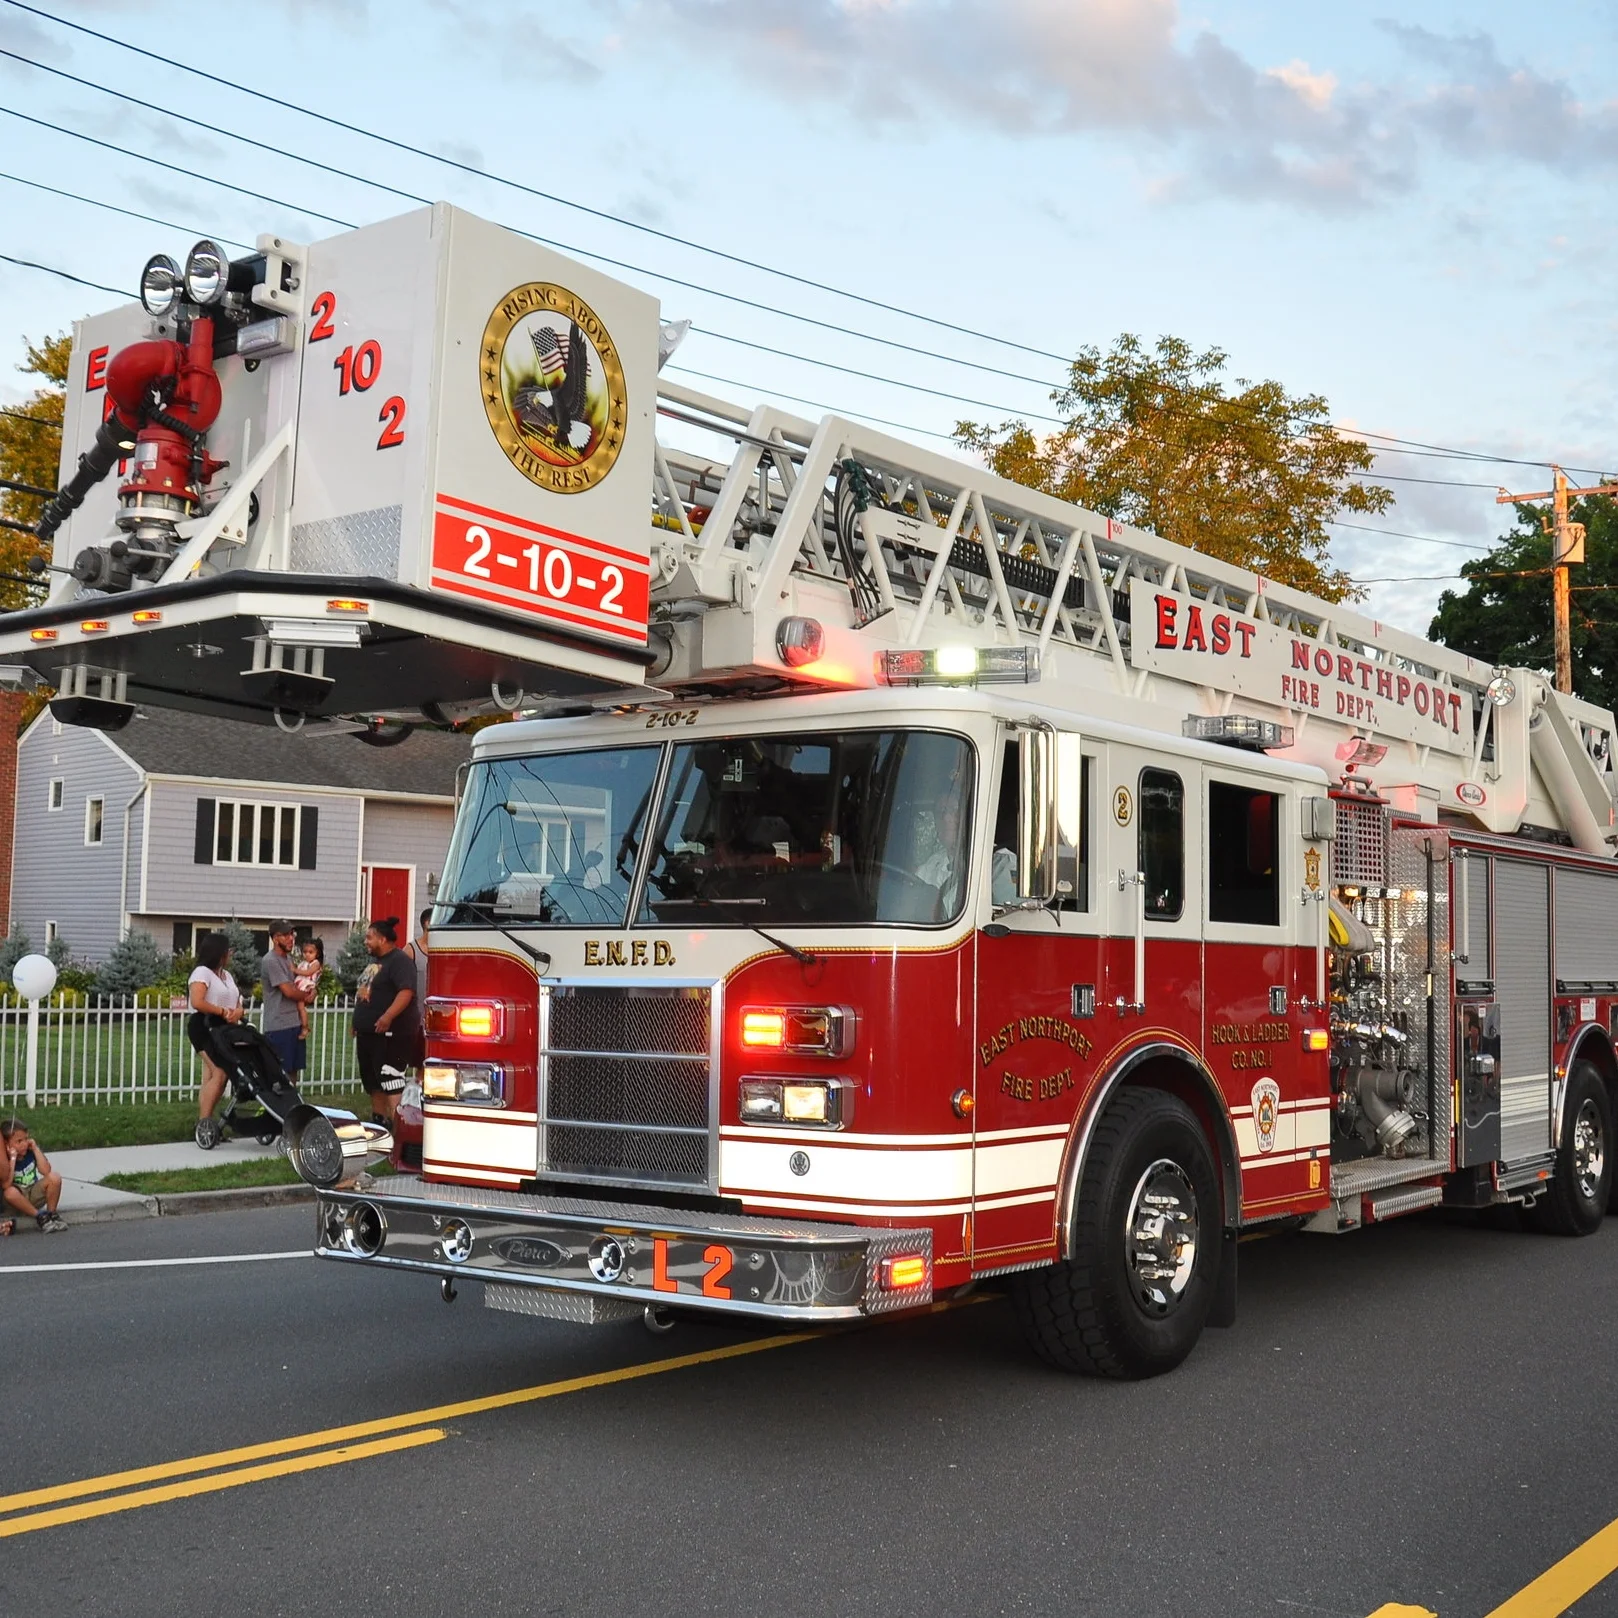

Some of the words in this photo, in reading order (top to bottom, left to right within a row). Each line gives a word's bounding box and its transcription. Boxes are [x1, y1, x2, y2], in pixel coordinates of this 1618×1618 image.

[308, 290, 337, 344] 2
[501, 287, 558, 322] RISING
[565, 299, 614, 362] ABOVE
[333, 339, 383, 396] 10
[376, 395, 407, 451] 2
[511, 442, 545, 482] THE
[552, 466, 592, 488] REST
[463, 525, 624, 615] 2-10-2
[1154, 594, 1256, 658] EAST
[1290, 639, 1462, 735] NORTHPORT
[1281, 674, 1320, 708] FIRE
[646, 709, 700, 729] 2-10-2
[1117, 792, 1128, 820] 2
[980, 1022, 1015, 1067] EAST
[1018, 1015, 1093, 1061] NORTHPORT
[1211, 1023, 1241, 1045] HOOK
[1251, 1022, 1290, 1043] LADDER
[1000, 1071, 1034, 1101] FIRE
[1039, 1066, 1075, 1101] DEPT.
[1231, 1050, 1249, 1070] CO.
[653, 1238, 678, 1293] L
[703, 1244, 733, 1300] 2
